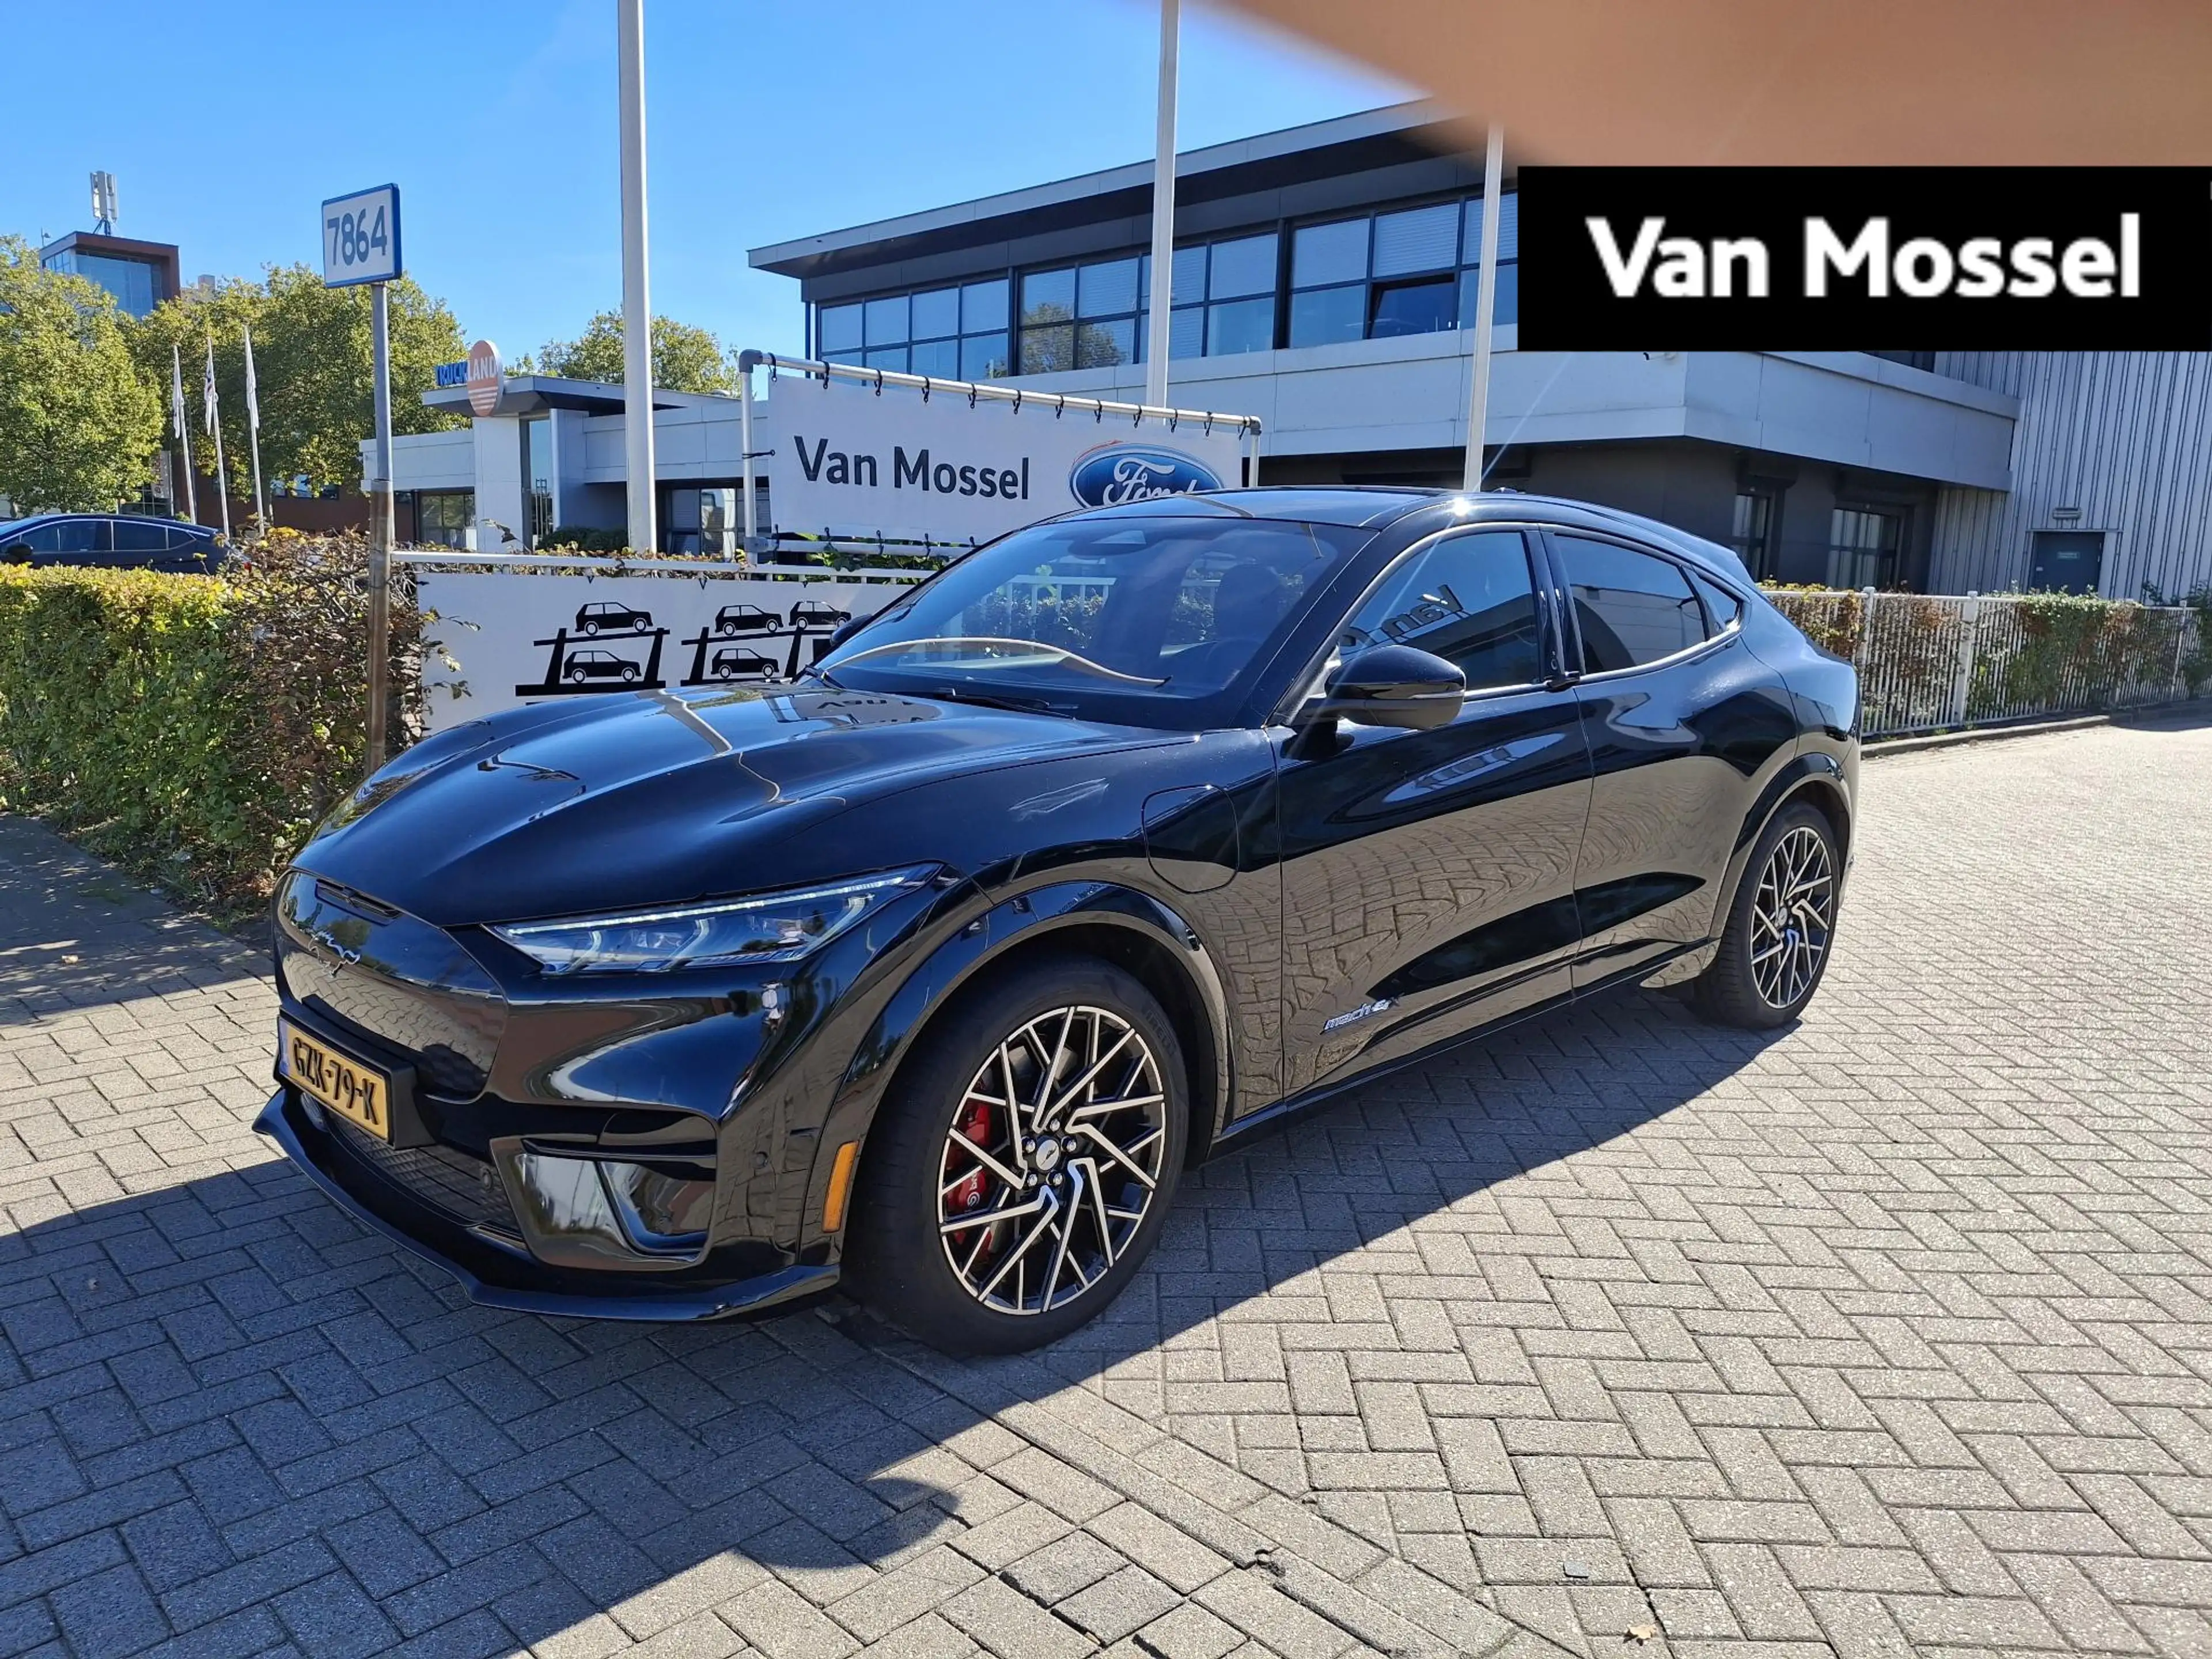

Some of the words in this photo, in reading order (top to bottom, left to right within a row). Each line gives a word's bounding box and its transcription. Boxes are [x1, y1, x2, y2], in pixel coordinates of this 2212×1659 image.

[327, 205, 388, 267] 7864
[793, 435, 878, 487] Van
[893, 445, 1029, 500] Mossel
[293, 1036, 379, 1126] GZK-79-K
